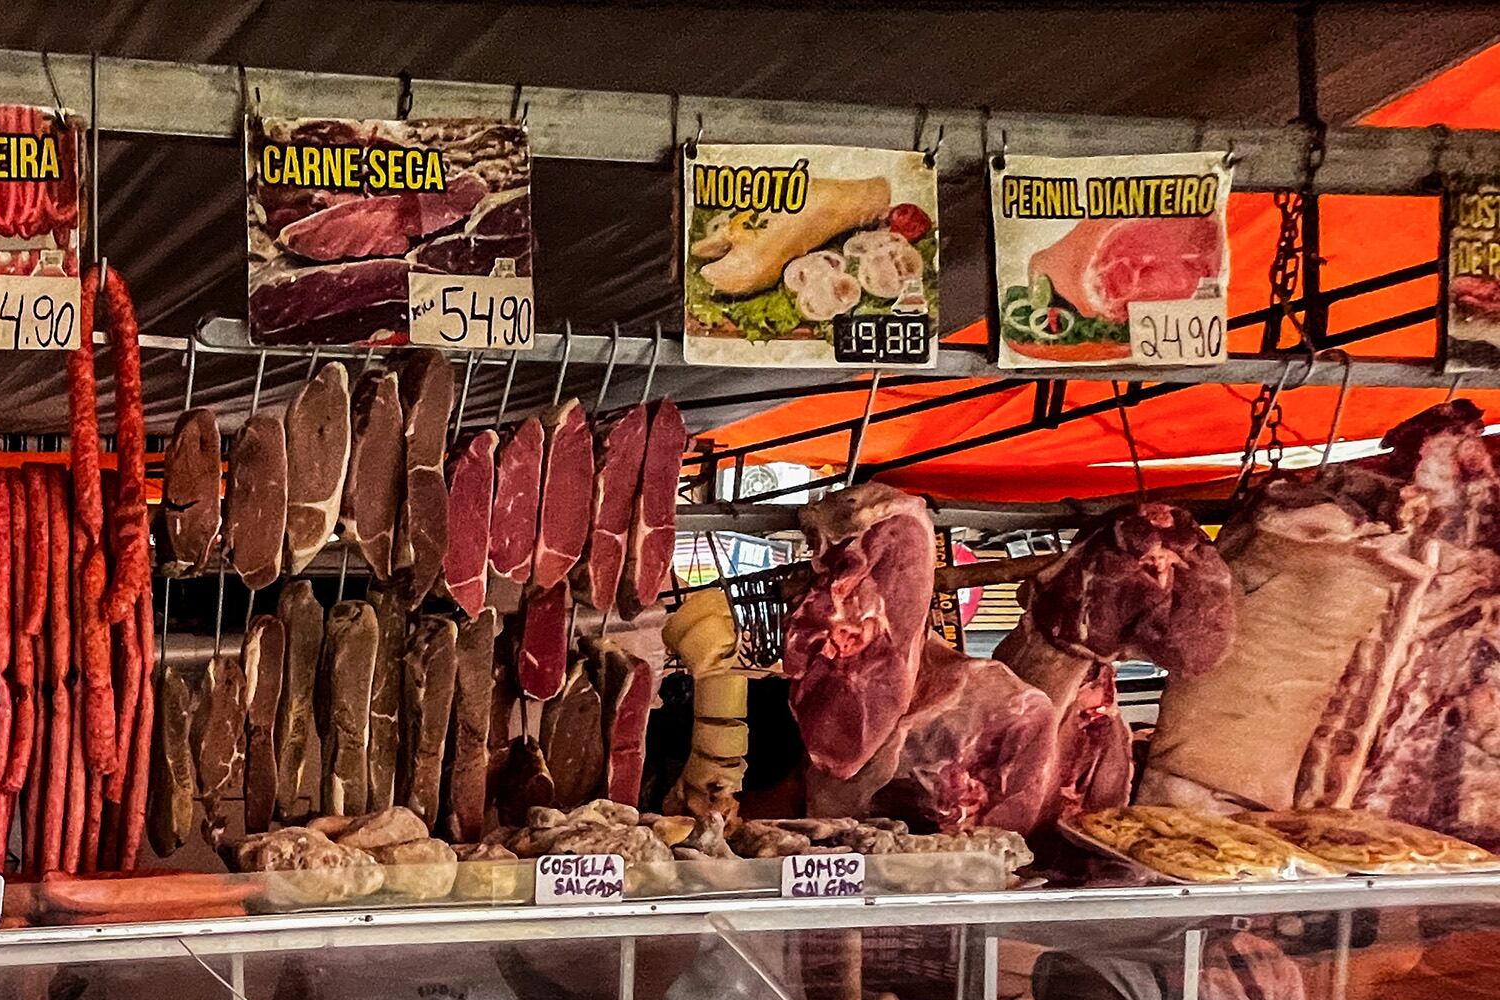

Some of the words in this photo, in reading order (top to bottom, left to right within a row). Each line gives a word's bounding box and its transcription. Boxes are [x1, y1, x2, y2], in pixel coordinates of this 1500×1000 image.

[263, 145, 360, 189] CARNE
[368, 149, 447, 191] SECA
[695, 161, 806, 211] MOCOTÓ
[1003, 177, 1078, 218] PERNIL
[1088, 174, 1219, 217] DIANTEIRO
[540, 856, 617, 878] COSTELA
[792, 857, 859, 878] LOMBO
[554, 877, 623, 898] SALGADA
